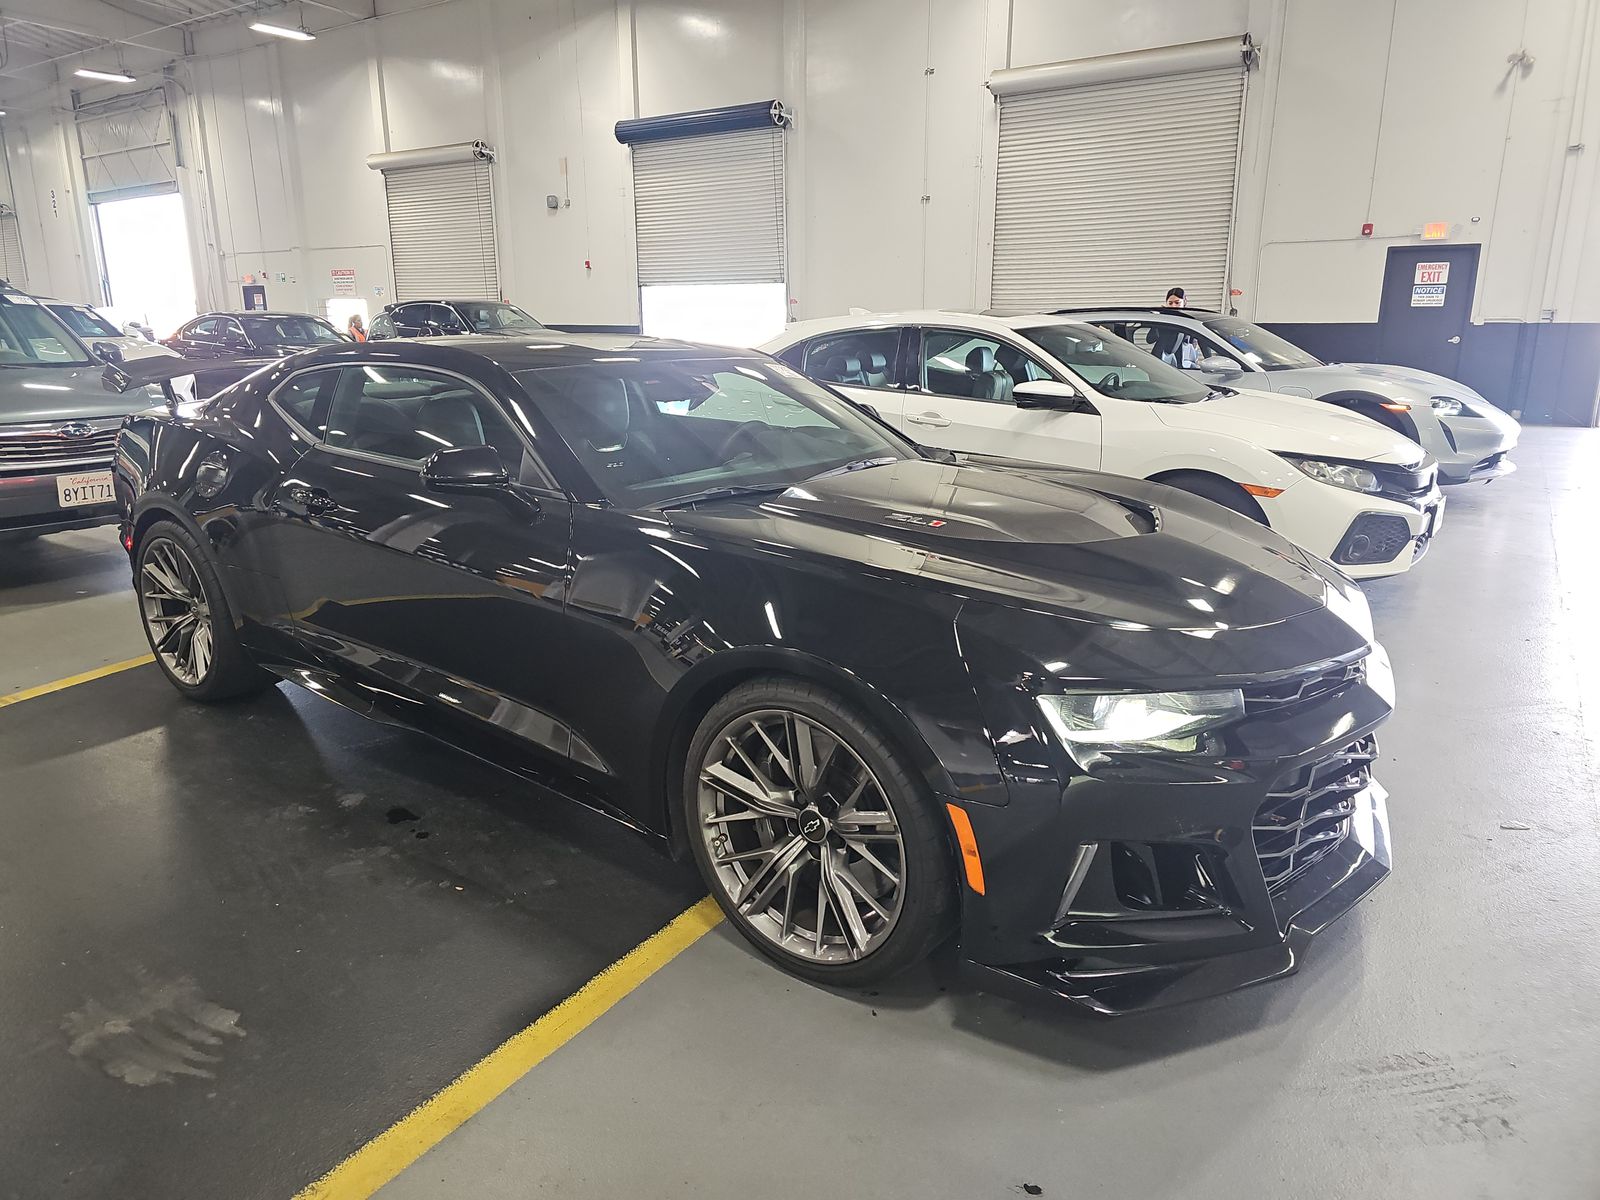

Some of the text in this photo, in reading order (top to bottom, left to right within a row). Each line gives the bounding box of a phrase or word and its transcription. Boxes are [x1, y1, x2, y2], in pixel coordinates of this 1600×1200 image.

[1420, 271, 1442, 282] EXIT
[71, 476, 108, 485] California
[63, 484, 113, 502] 8YIT71
